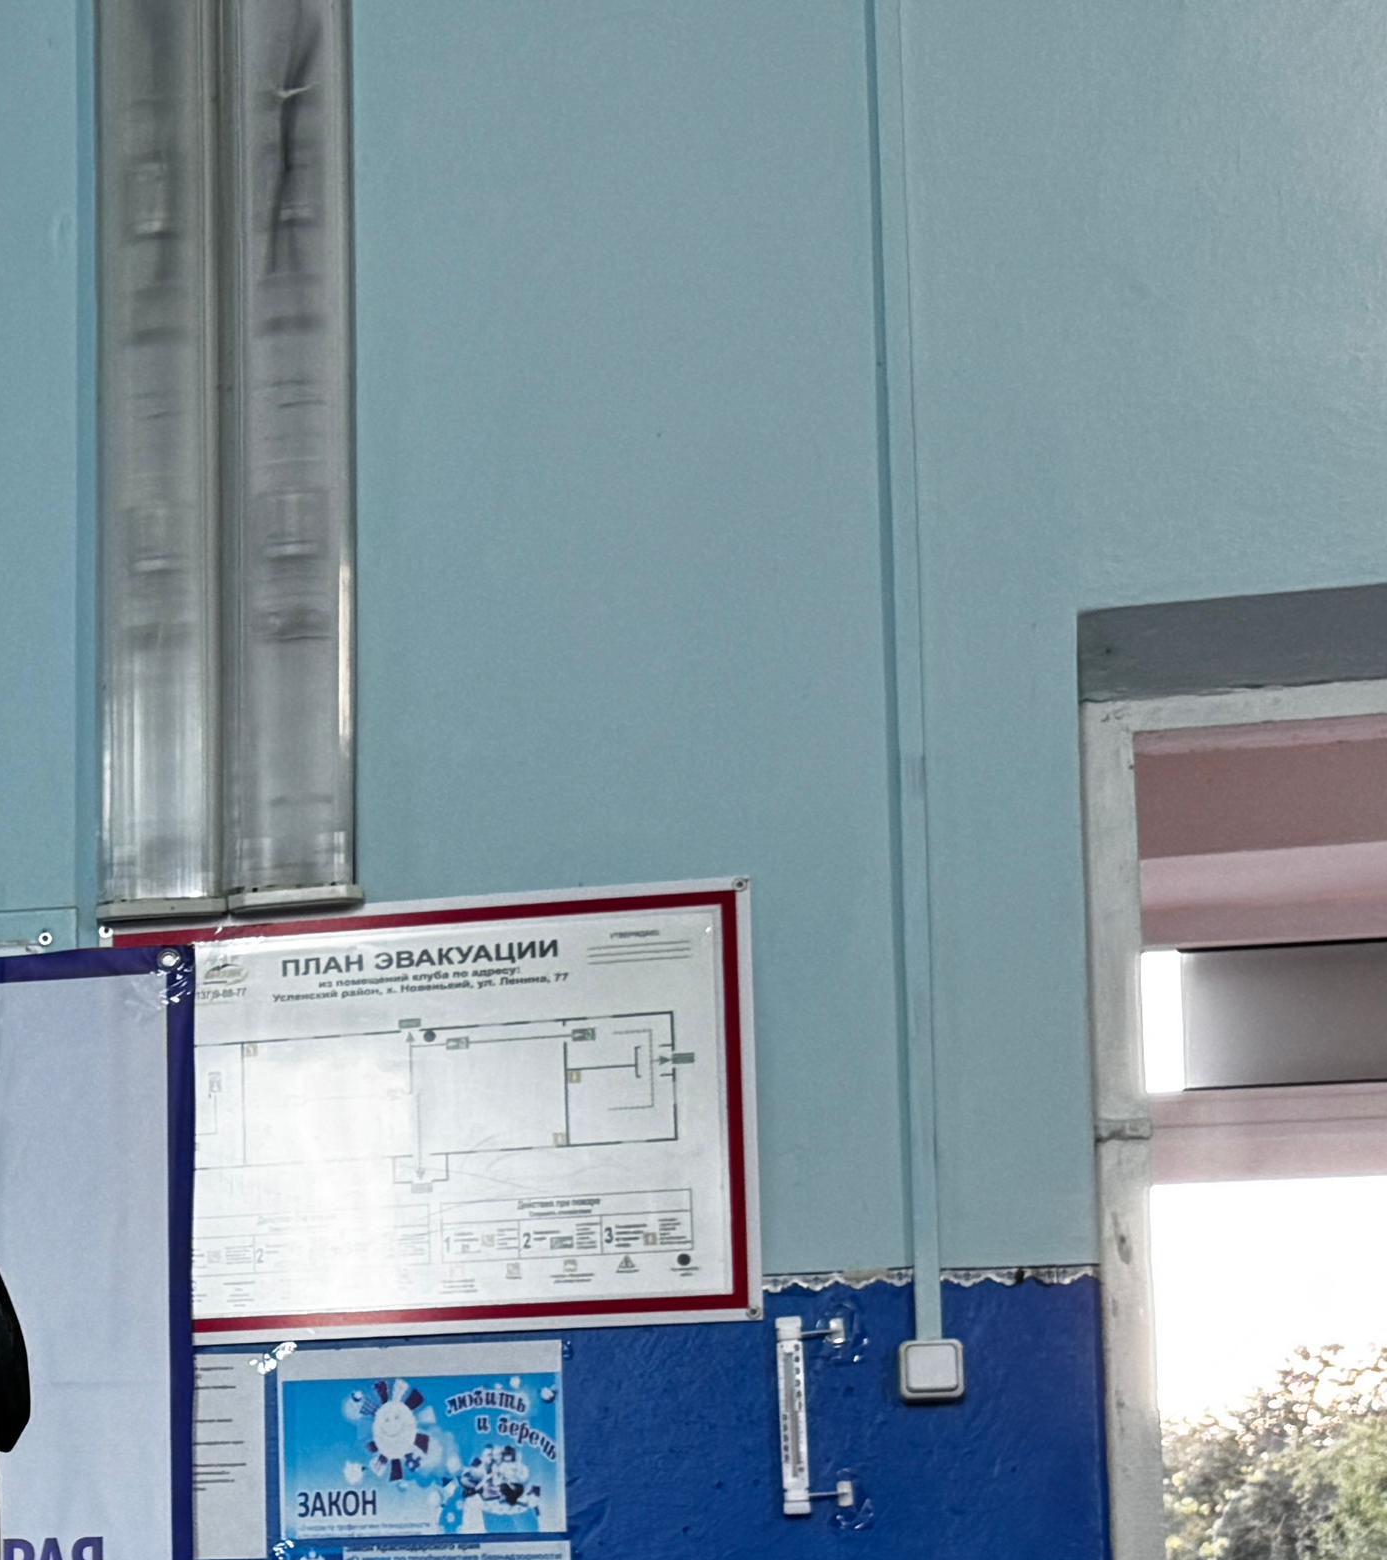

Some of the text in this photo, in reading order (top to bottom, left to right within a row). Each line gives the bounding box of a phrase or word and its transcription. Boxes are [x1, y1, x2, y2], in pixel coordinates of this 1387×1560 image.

[282, 939, 559, 977] ПЛАН ЭВАКУАЦИИ
[318, 980, 333, 989] из
[452, 970, 468, 979] по
[554, 972, 569, 982] 77
[522, 1232, 532, 1250] 2
[603, 1227, 615, 1244] 3
[446, 1389, 527, 1416] любить
[476, 1416, 491, 1432] и
[297, 1489, 377, 1518] ЗАКОН
